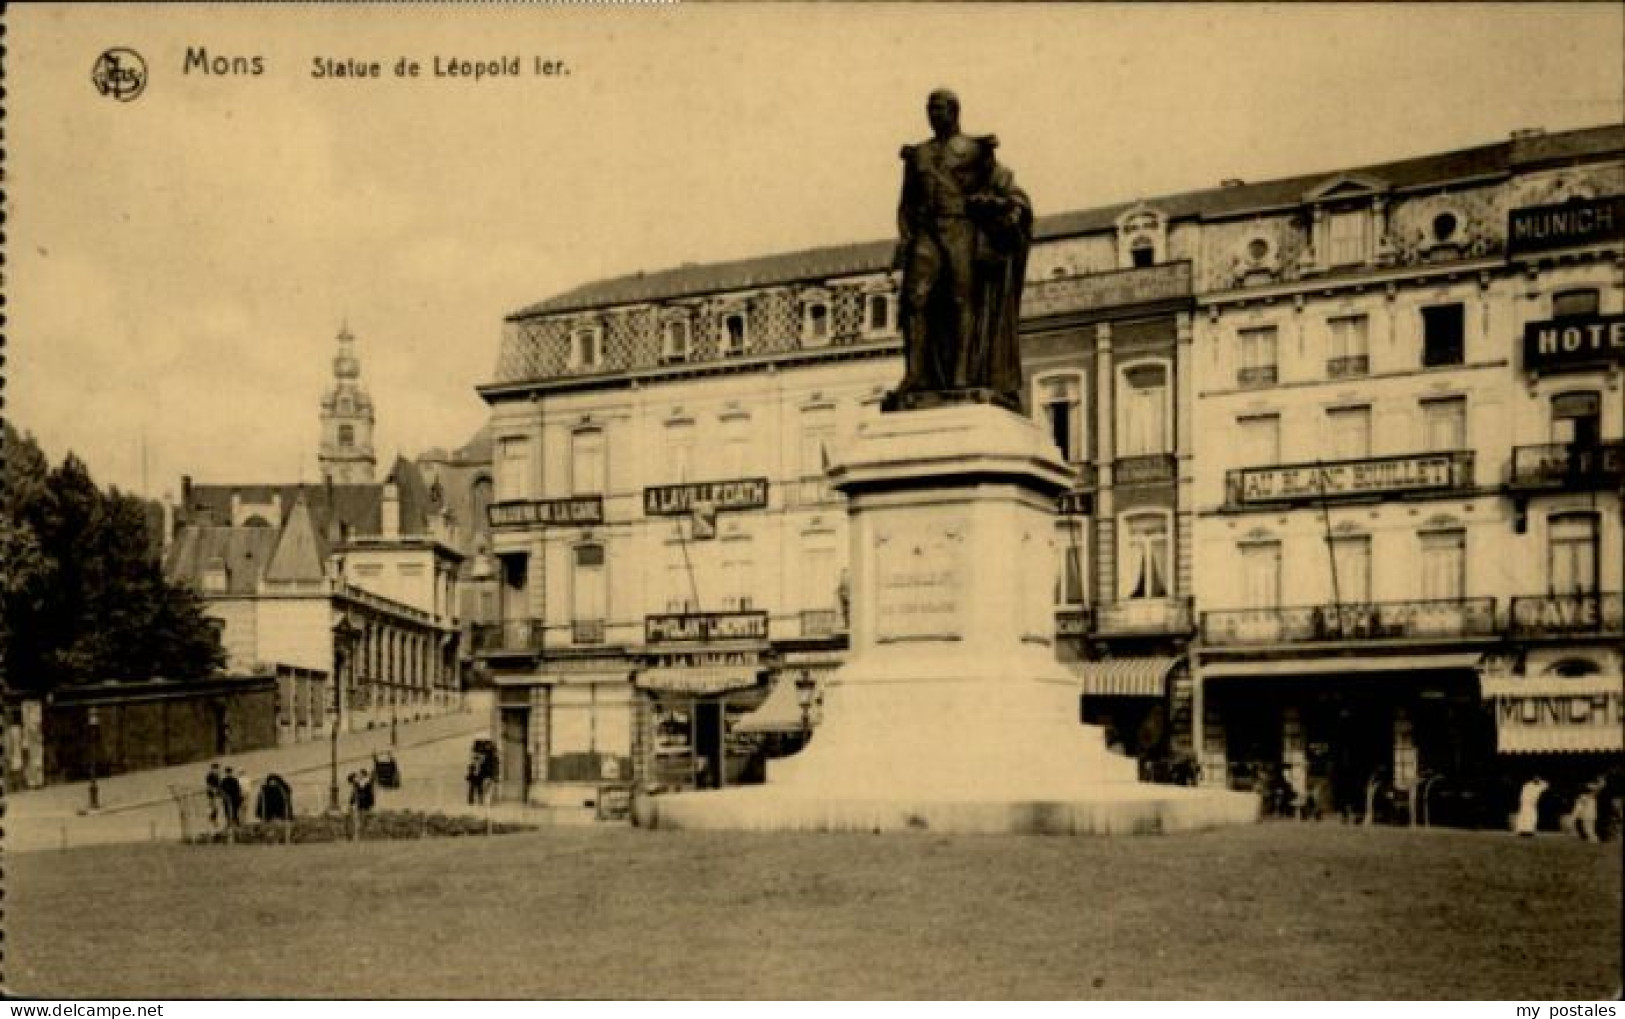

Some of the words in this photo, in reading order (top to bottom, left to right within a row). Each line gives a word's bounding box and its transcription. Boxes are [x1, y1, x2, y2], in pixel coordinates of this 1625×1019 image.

[1515, 204, 1613, 239] MUNICH
[1538, 322, 1625, 354] HOTE
[1500, 694, 1611, 726] MUNICH
